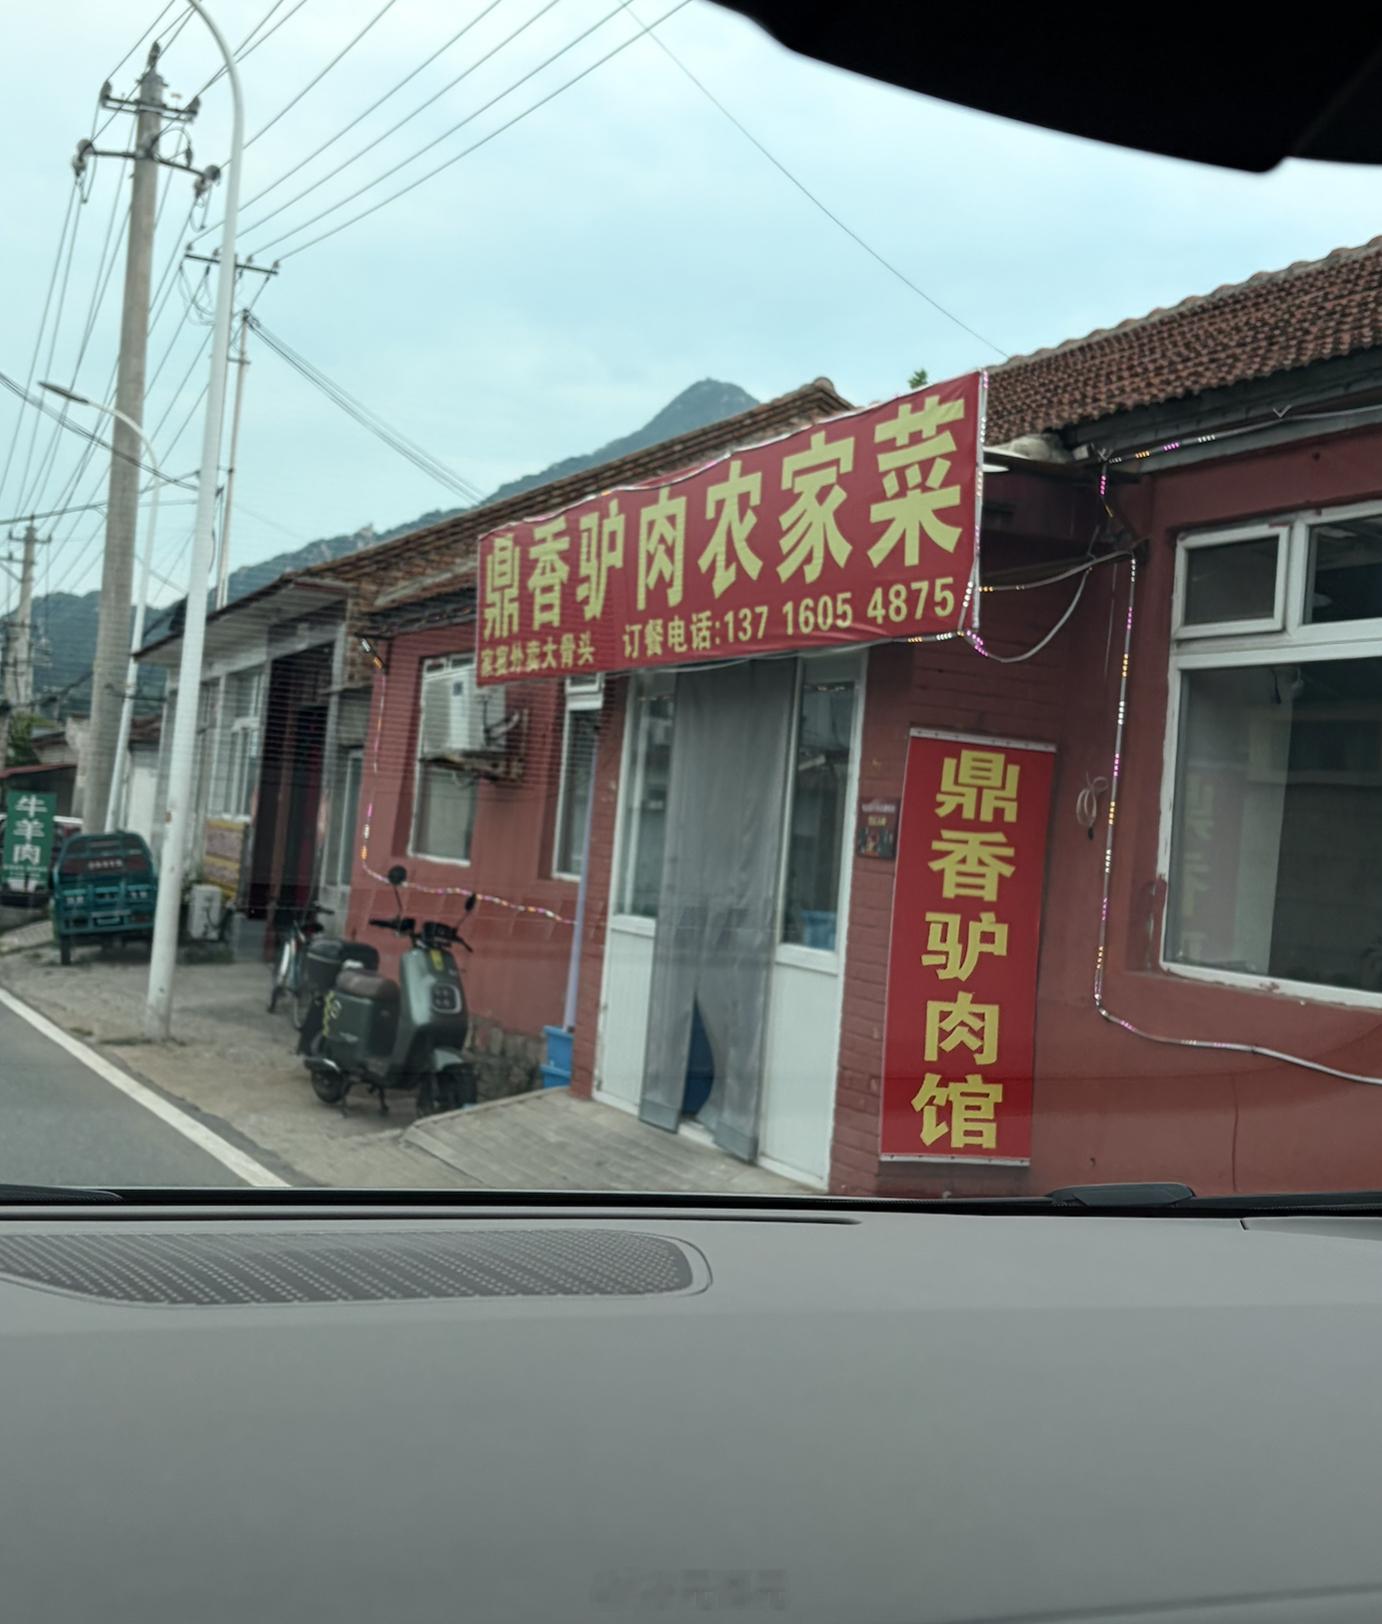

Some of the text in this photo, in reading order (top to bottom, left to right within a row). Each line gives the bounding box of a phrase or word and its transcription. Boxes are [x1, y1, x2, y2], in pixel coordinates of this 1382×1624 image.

[483, 394, 965, 640] 鼎香驴肉农家菜
[782, 592, 853, 636] 1605
[866, 577, 955, 625] 4875
[14, 794, 48, 866] 牛羊肉
[911, 749, 1021, 1150] 鼎香驴肉馆
